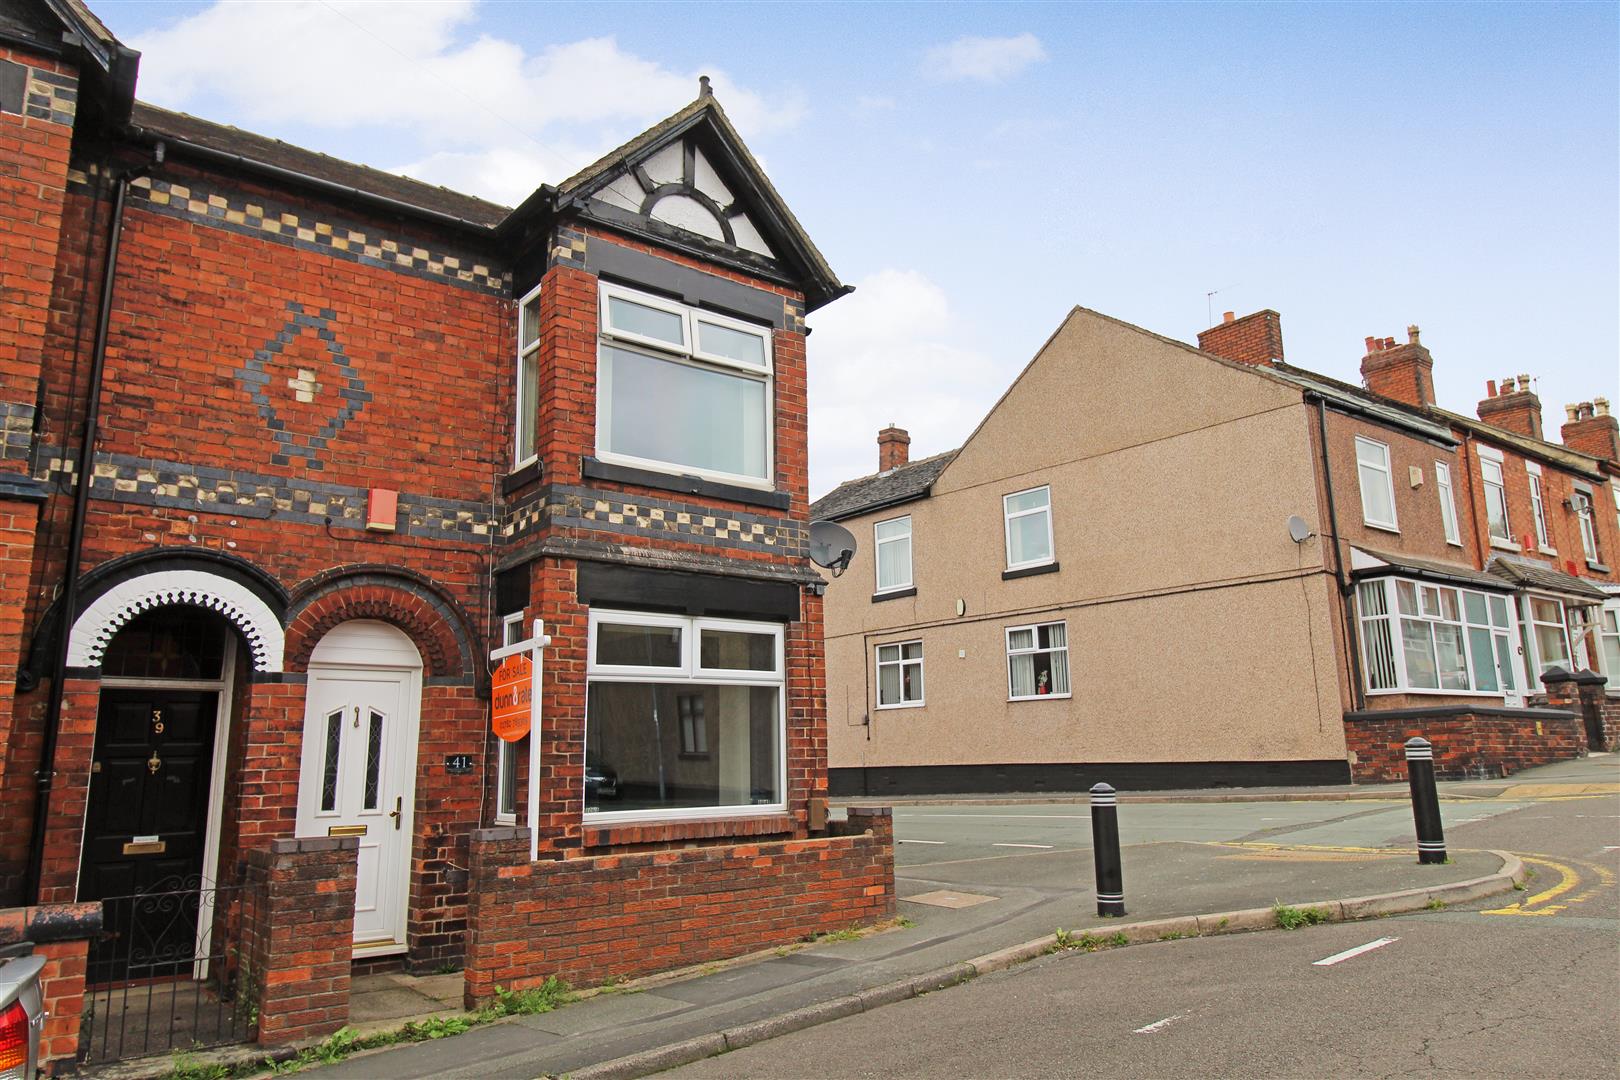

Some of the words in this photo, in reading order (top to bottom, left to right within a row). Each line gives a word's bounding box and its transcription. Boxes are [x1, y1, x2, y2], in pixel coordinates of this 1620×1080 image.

[499, 670, 511, 682] FOR
[512, 663, 528, 677] SALE
[152, 710, 164, 734] 39
[452, 756, 466, 768] 41
